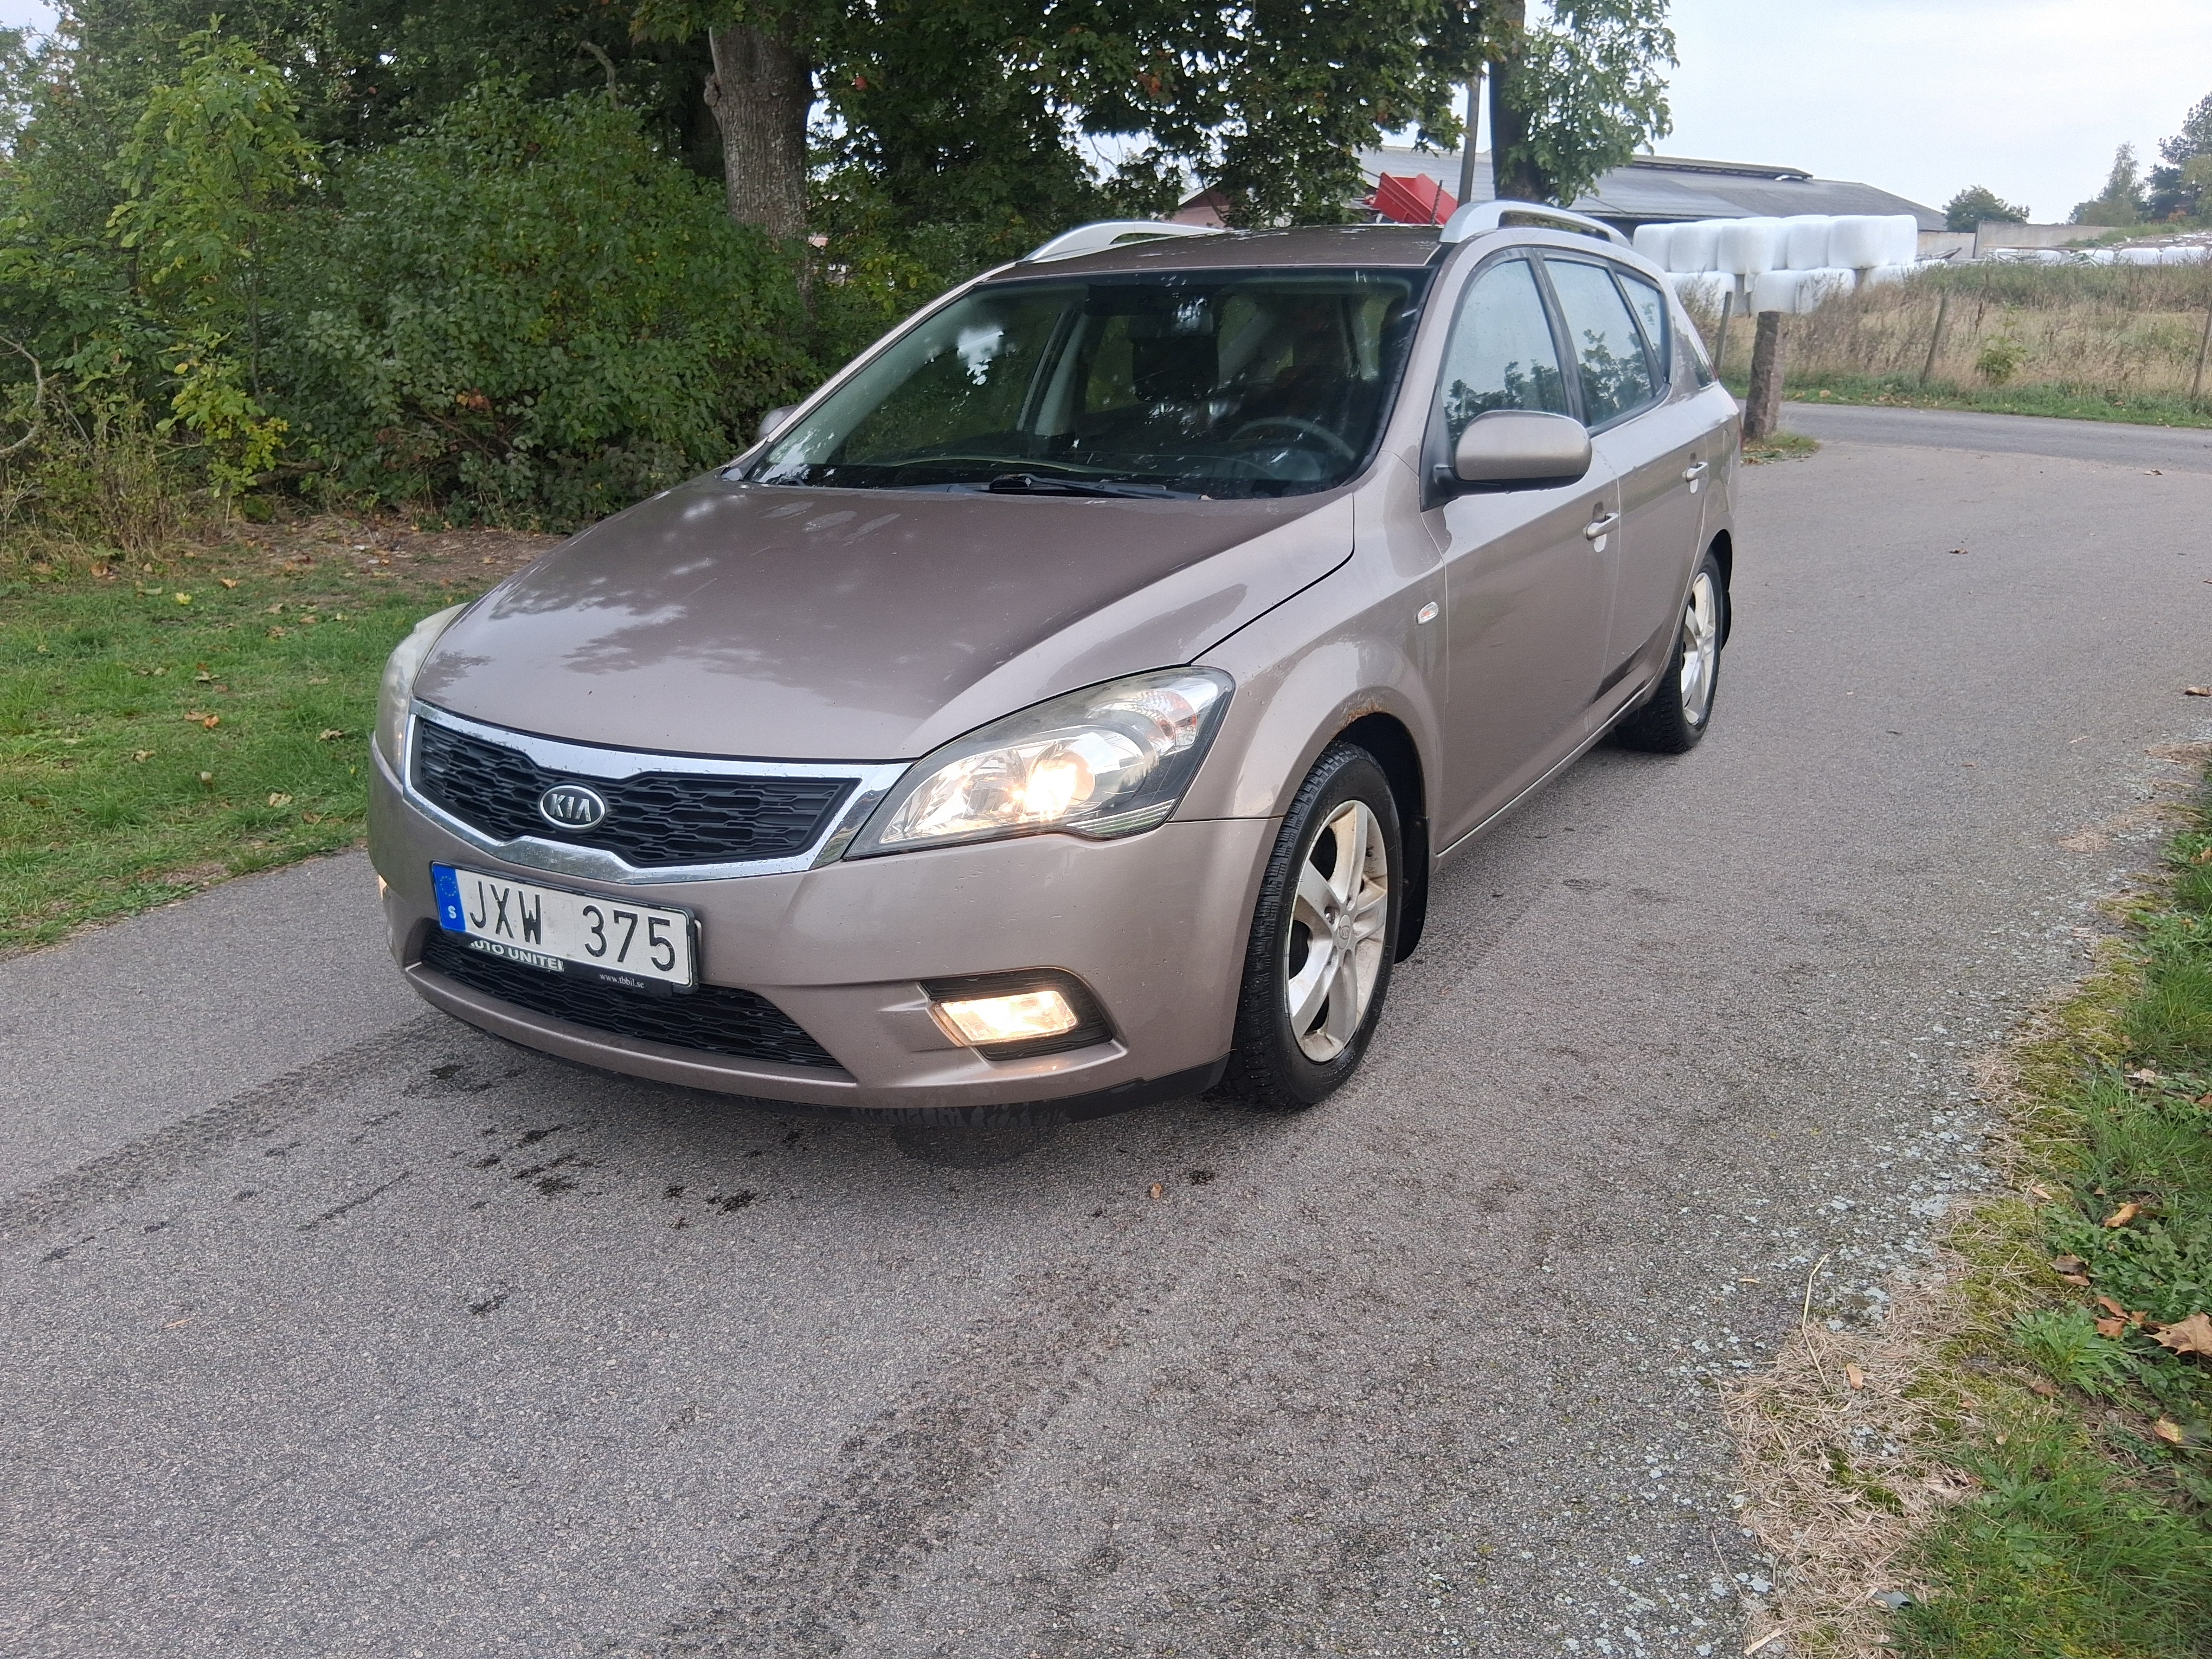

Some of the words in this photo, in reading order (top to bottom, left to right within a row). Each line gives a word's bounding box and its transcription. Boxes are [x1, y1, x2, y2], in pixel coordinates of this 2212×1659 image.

[549, 793, 591, 822] KIA
[448, 905, 457, 919] S
[470, 880, 542, 945] JXW
[582, 904, 677, 972] 375
